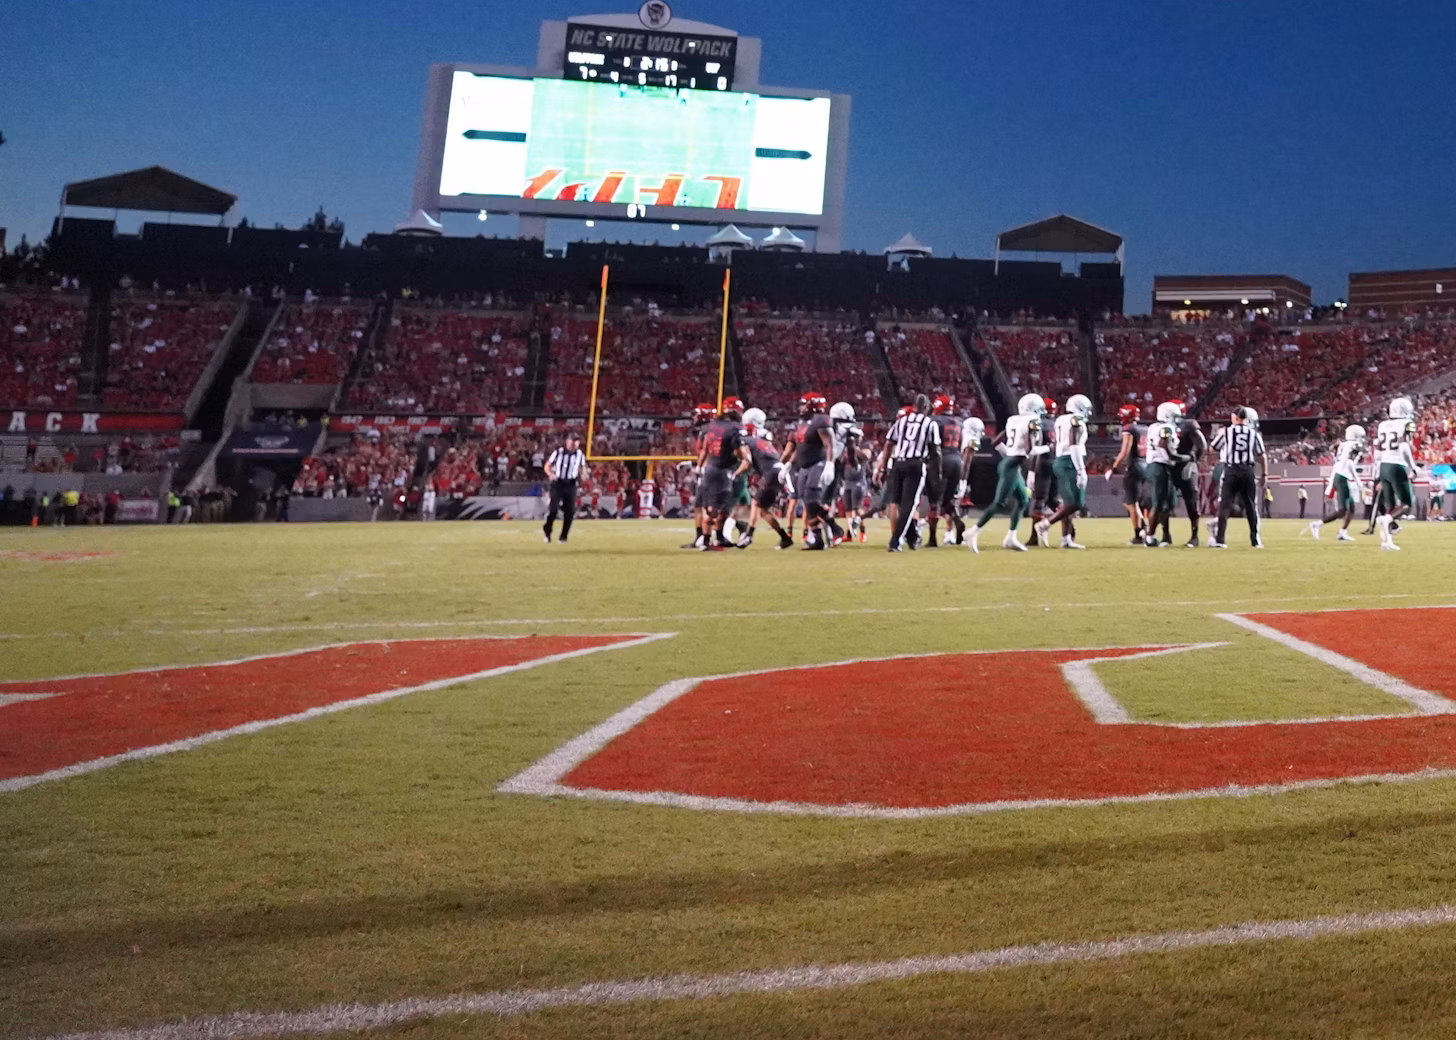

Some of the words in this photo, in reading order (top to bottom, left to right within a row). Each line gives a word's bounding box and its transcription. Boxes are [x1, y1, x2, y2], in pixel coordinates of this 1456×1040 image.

[570, 29, 595, 45] NC
[596, 32, 645, 50] STATE
[645, 36, 734, 57] WOLFPACK
[1235, 433, 1248, 451] S
[1379, 431, 1399, 451] 22
